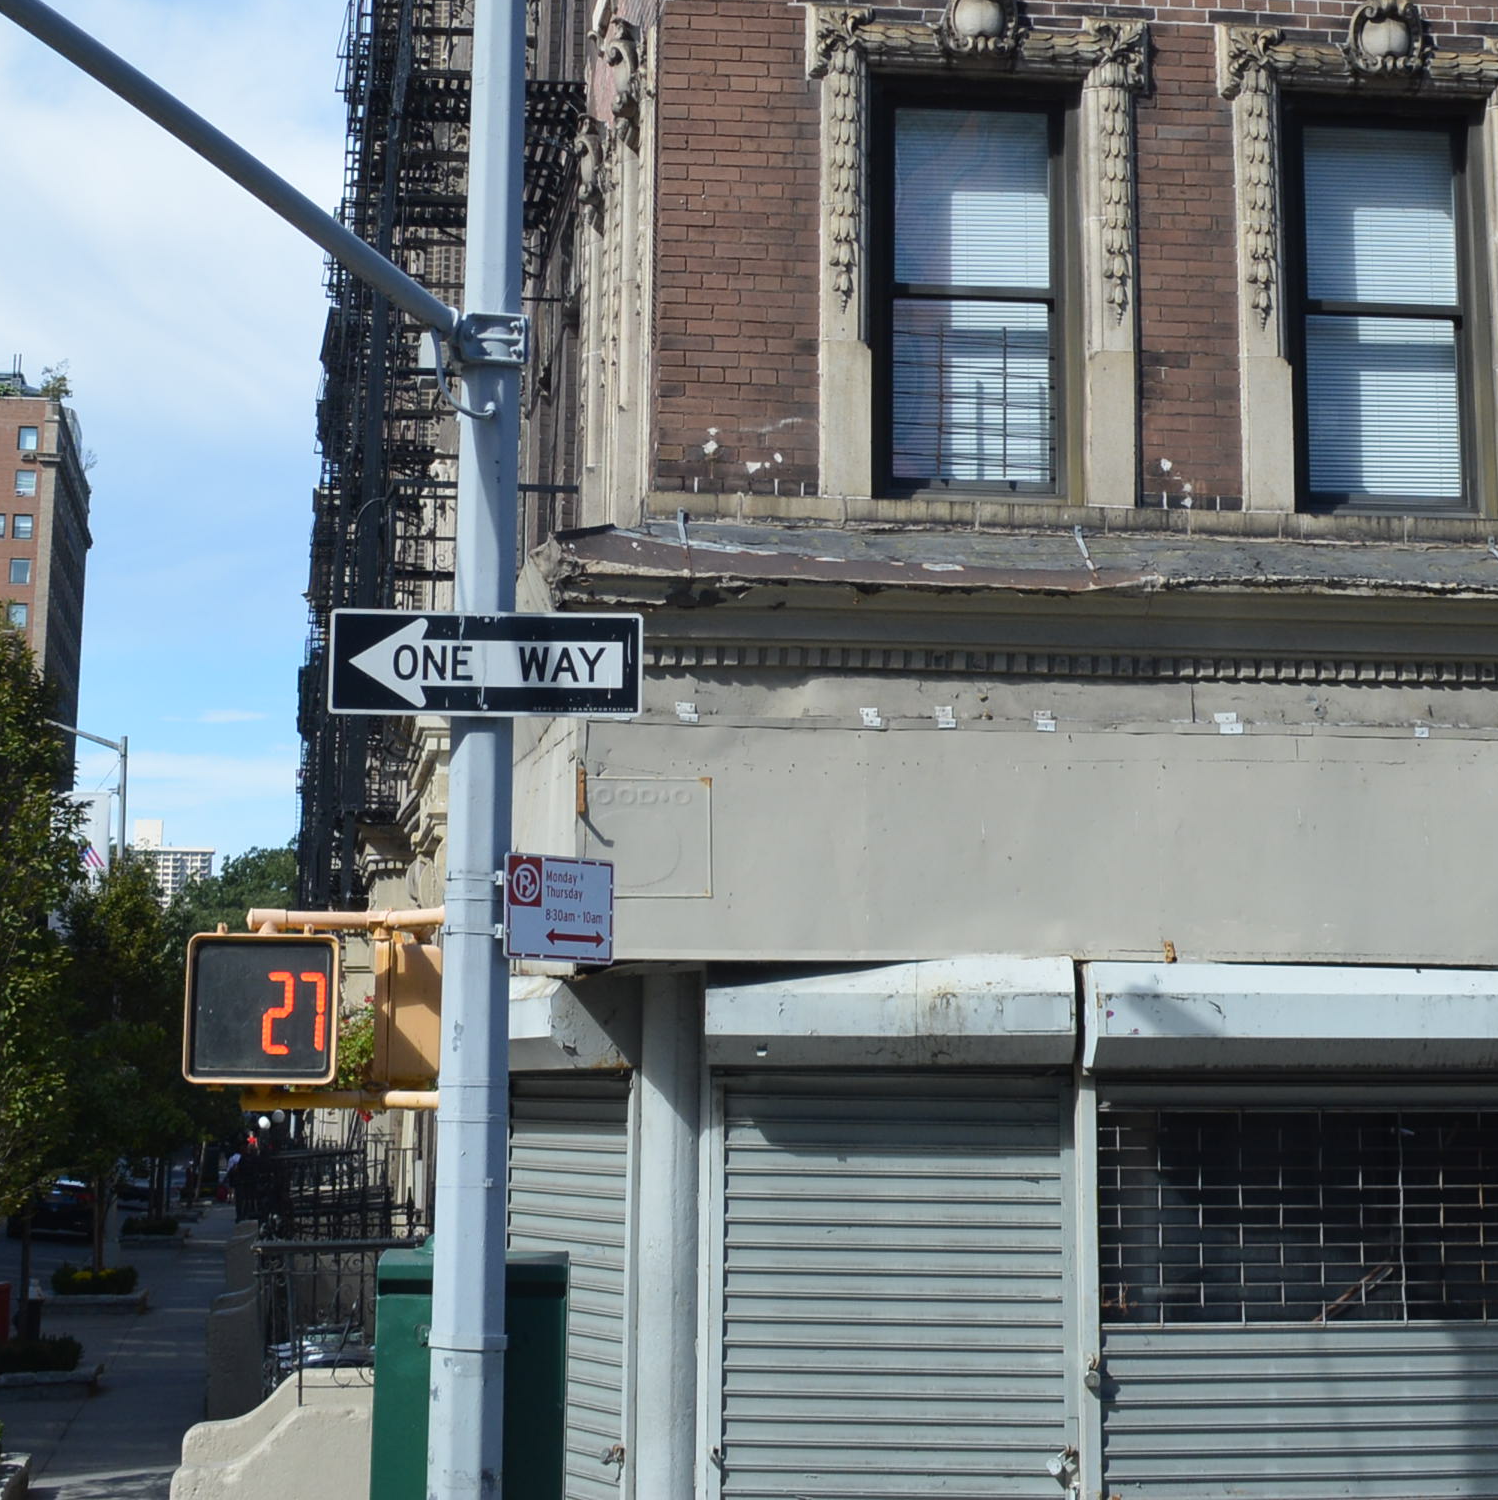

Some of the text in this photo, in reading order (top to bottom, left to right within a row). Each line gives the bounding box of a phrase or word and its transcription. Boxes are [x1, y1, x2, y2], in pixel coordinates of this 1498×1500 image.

[392, 644, 607, 683] ONE WAY
[545, 870, 579, 886] Monday
[546, 886, 583, 903] Thursday
[582, 911, 603, 925] 10am
[261, 971, 328, 1055] 27
